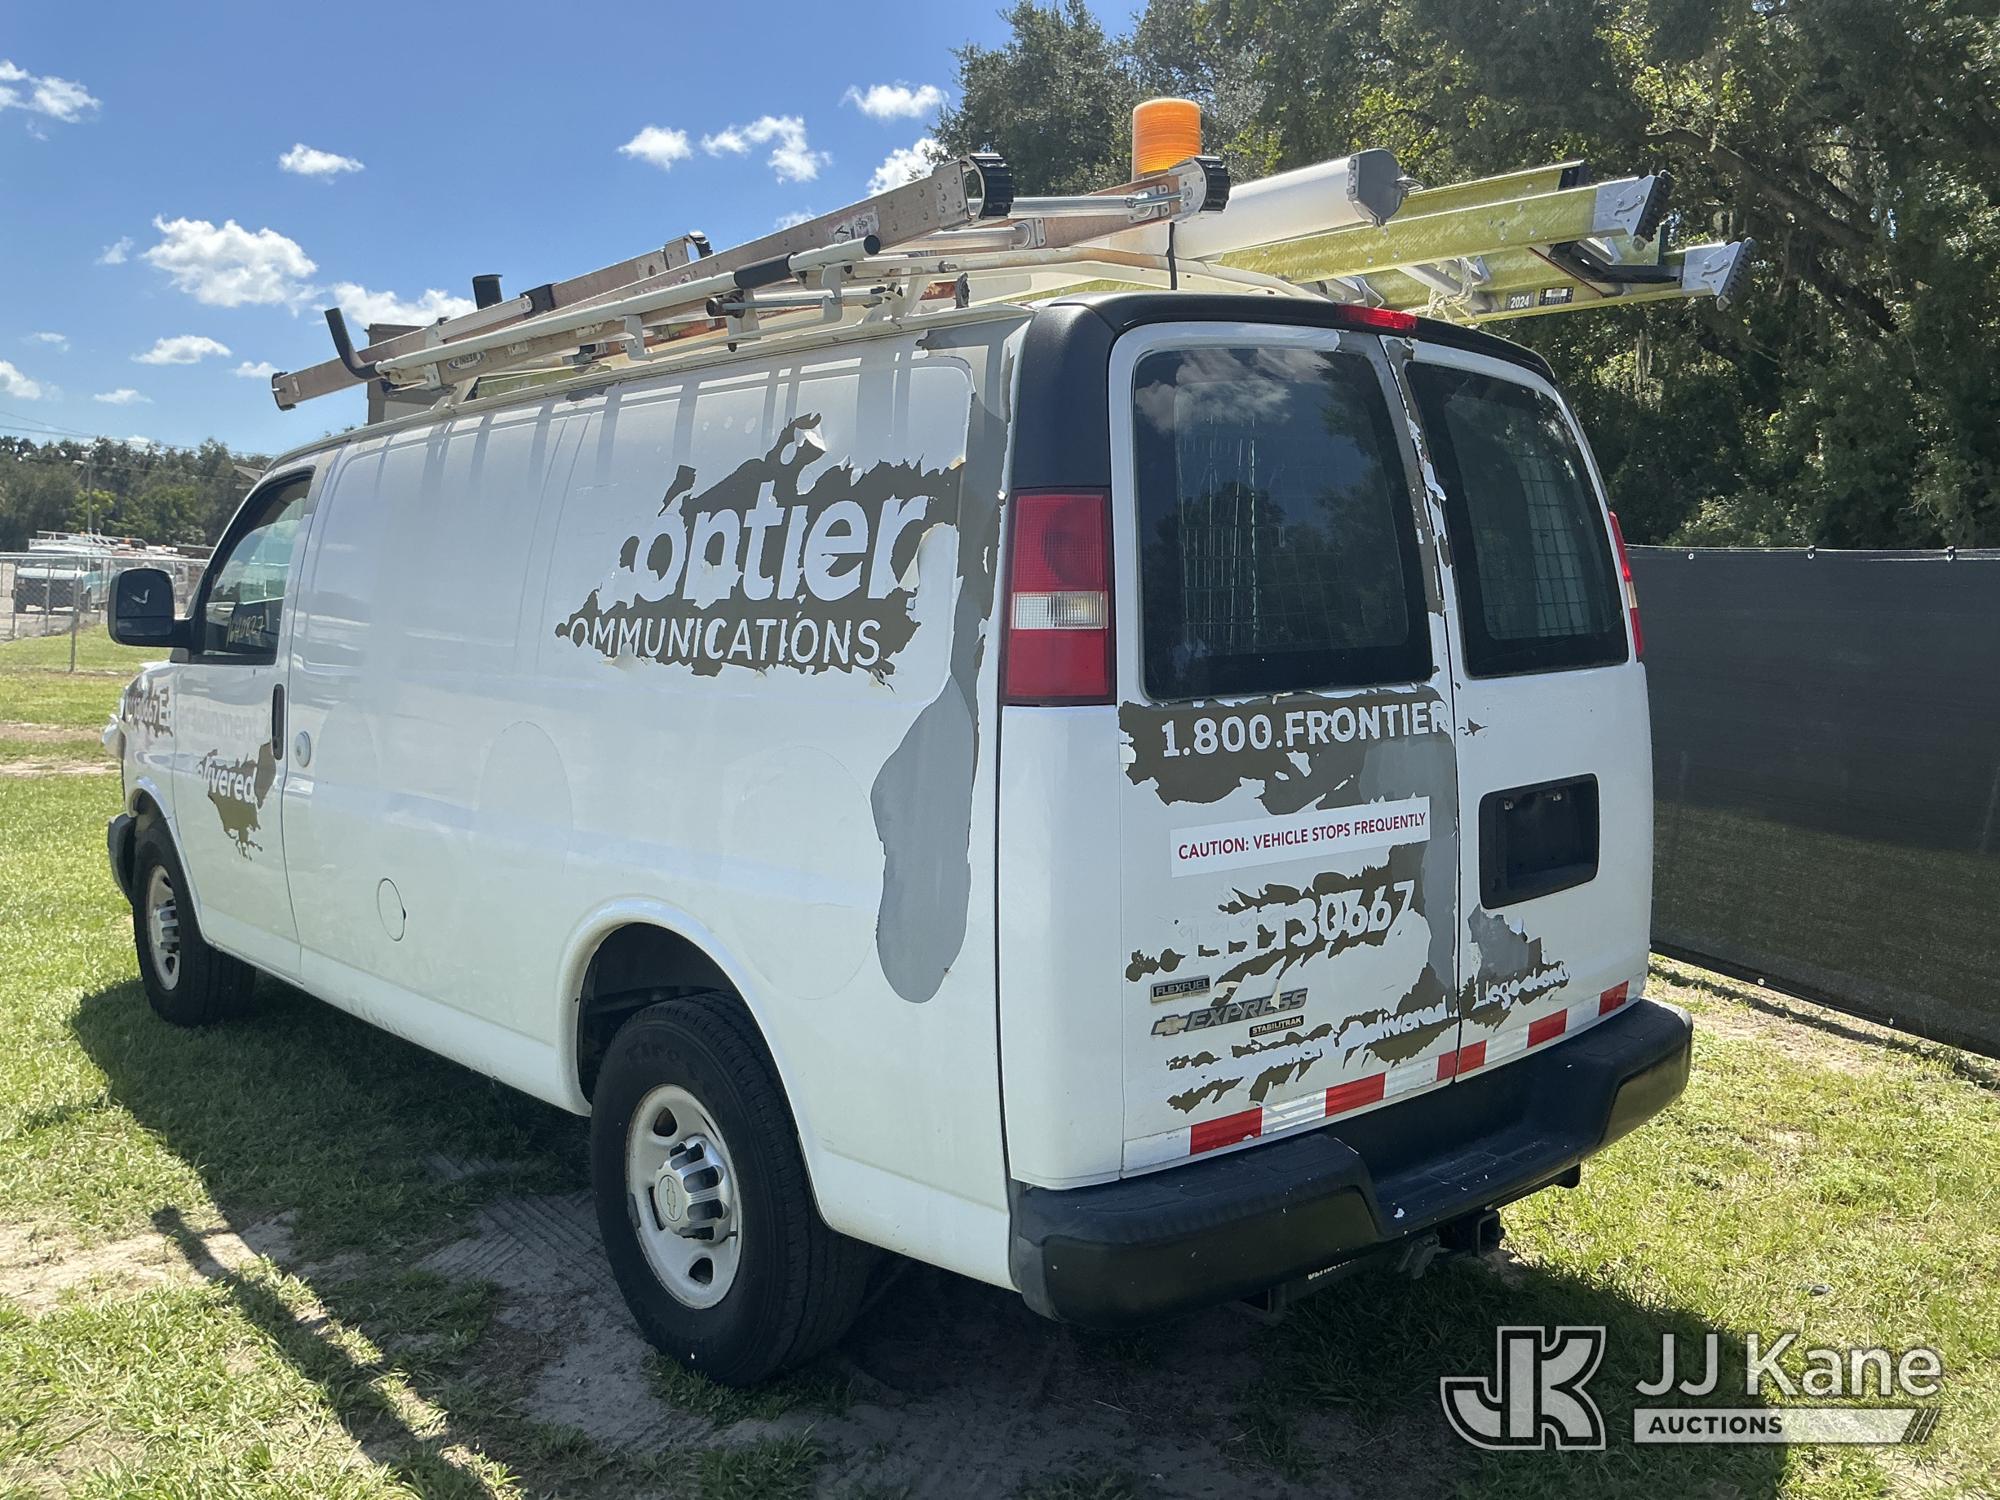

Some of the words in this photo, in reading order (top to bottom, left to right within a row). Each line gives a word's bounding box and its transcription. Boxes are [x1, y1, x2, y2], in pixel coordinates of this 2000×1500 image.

[1510, 295, 1530, 309] 2024
[1161, 700, 1450, 757] 1.800.FRONTIER
[1178, 836, 1250, 860] CAUTION:
[1253, 829, 1308, 850] VEHICLE
[1312, 822, 1351, 842] STOPS
[1354, 811, 1427, 836] FREQUENTLY
[1155, 978, 1209, 997] FLEXFUEL
[1187, 988, 1308, 1031] EXPRESS
[1252, 1017, 1302, 1034] STABILITRAK
